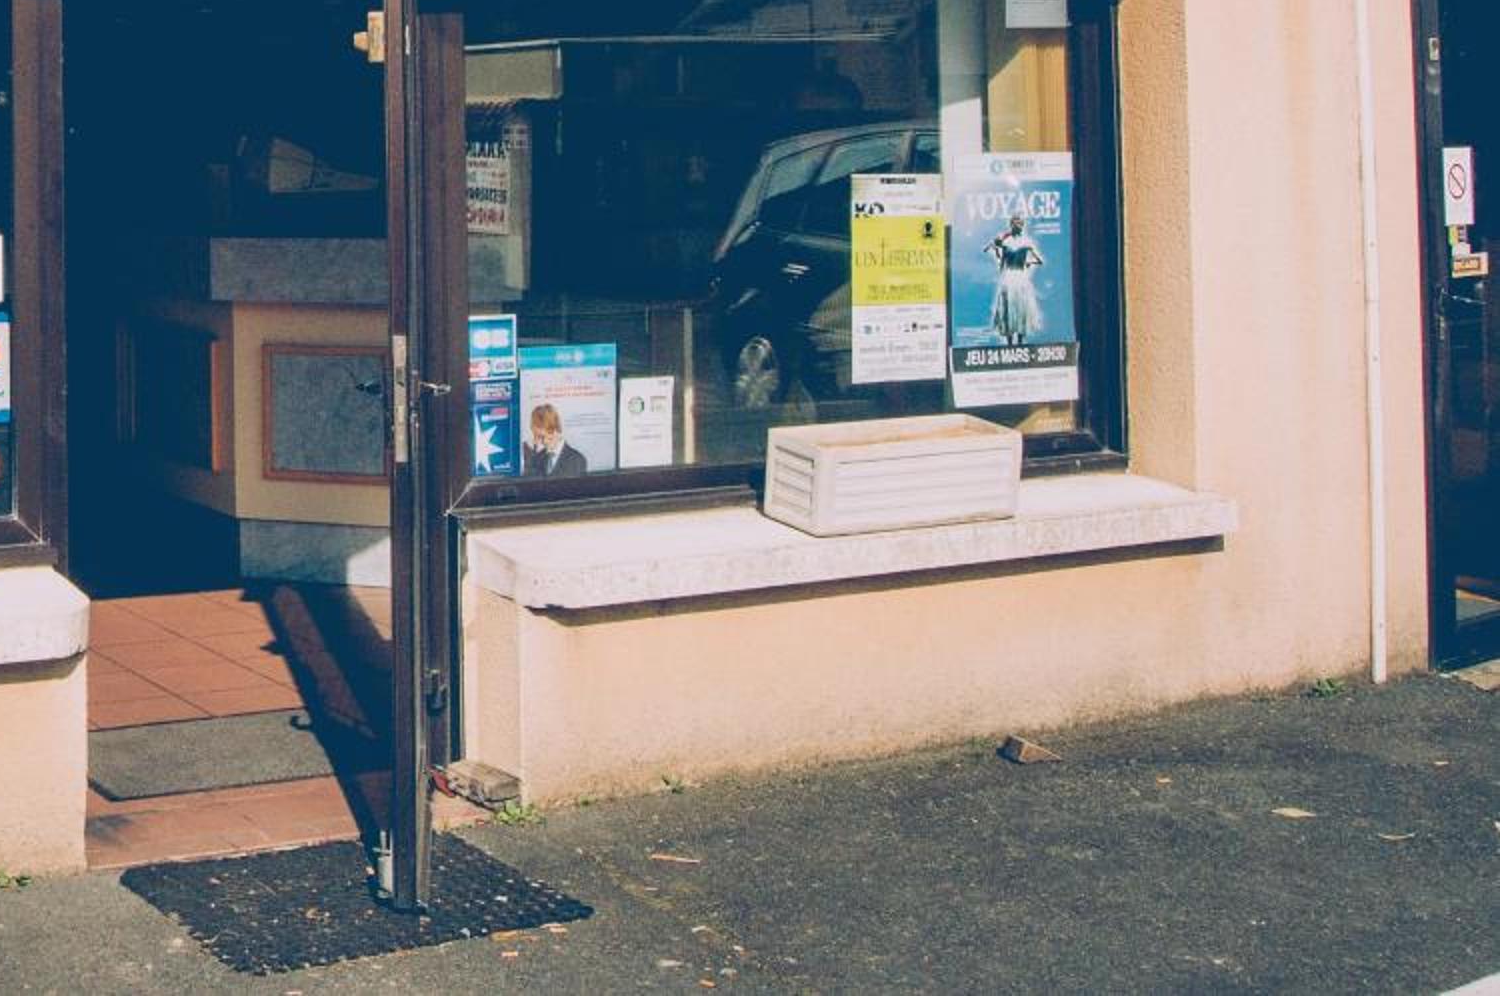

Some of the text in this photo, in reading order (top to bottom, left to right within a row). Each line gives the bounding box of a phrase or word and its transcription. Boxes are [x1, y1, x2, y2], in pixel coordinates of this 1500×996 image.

[963, 190, 1061, 220] VOYAGE
[964, 349, 985, 367] JEU
[1000, 346, 1029, 364] MARS
